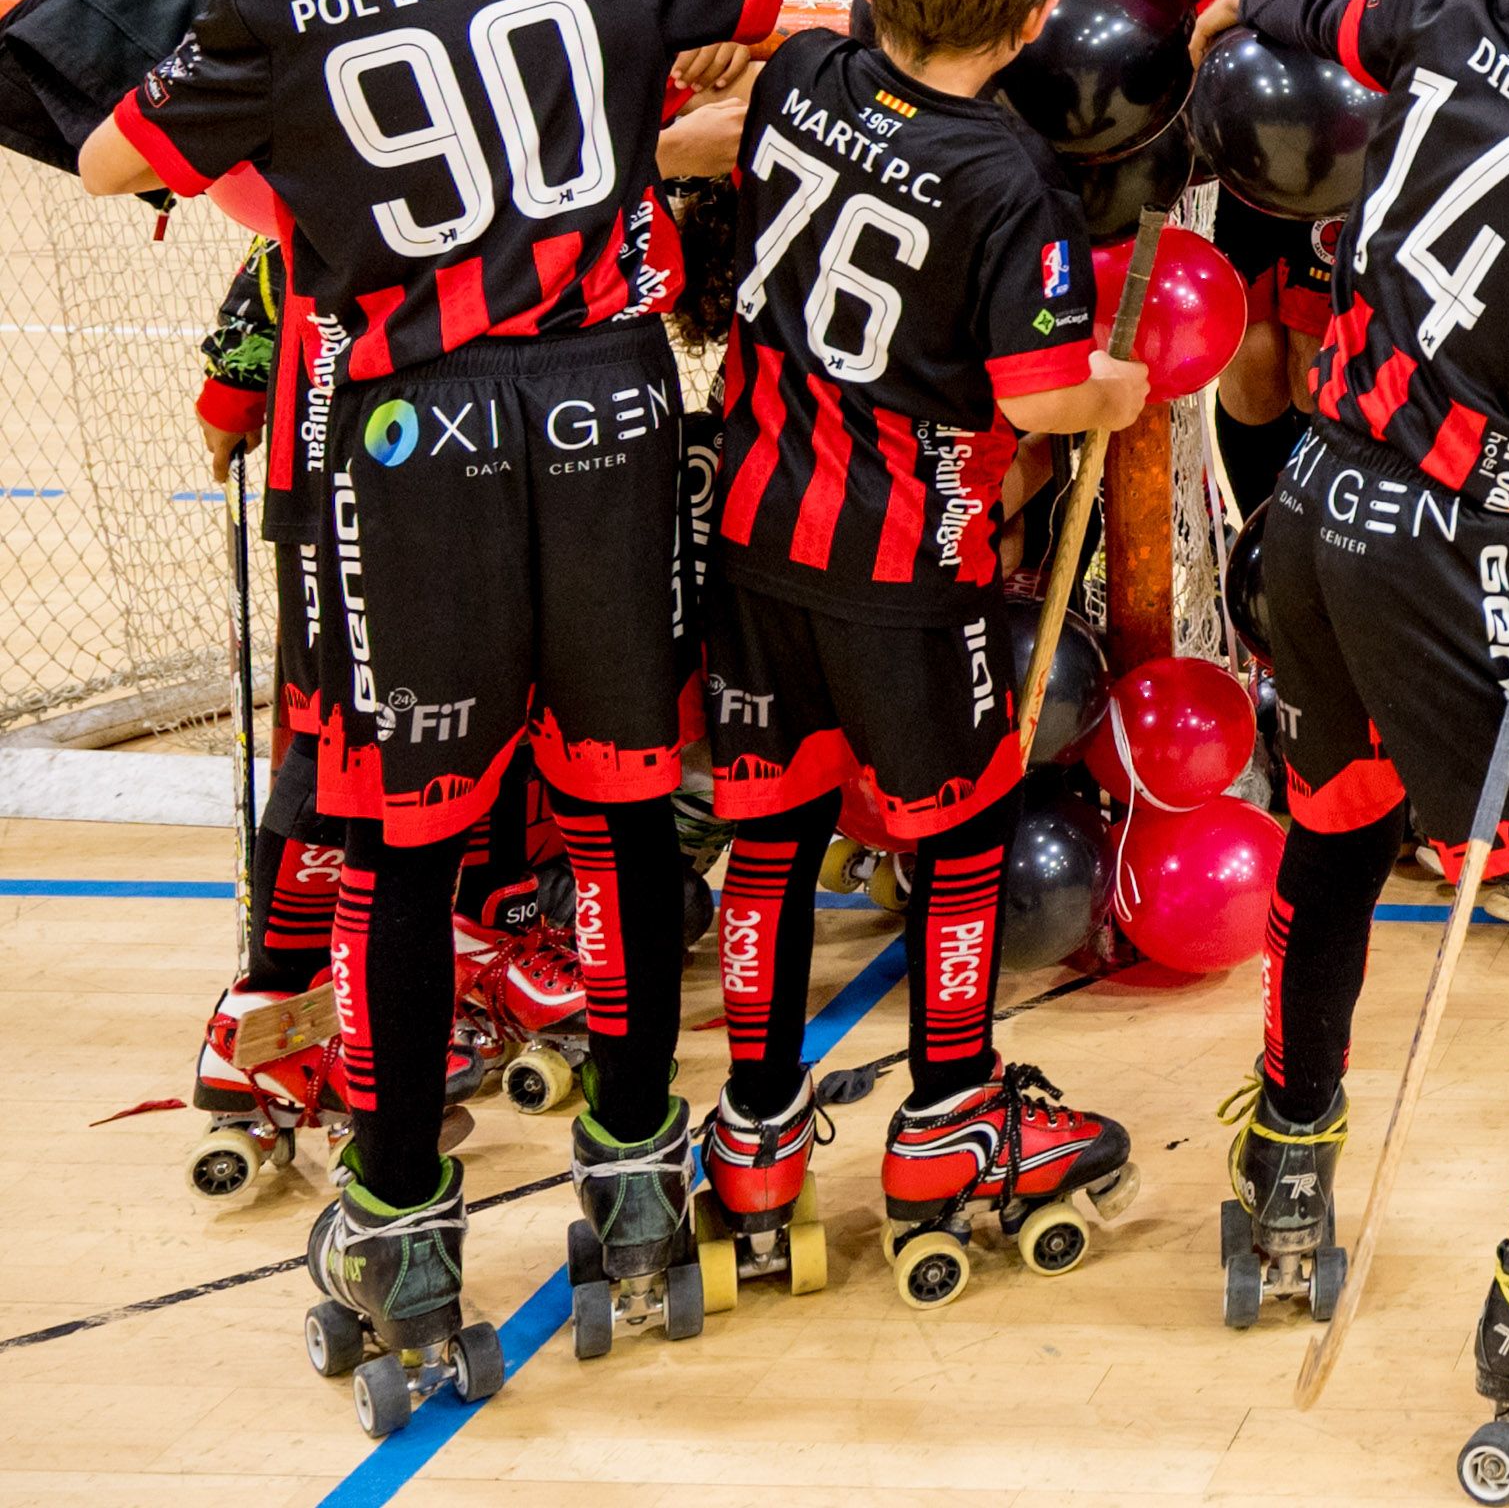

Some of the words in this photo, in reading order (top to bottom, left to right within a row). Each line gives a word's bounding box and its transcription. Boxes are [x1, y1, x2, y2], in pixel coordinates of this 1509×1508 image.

[781, 88, 889, 174] MARTÍ
[882, 155, 943, 209] P.C.
[858, 107, 902, 139] 1967
[737, 124, 931, 384] 76
[466, 459, 511, 478] DATA
[548, 452, 628, 476] CENTER
[936, 443, 972, 499] Sant
[936, 498, 983, 569] Cugat
[1279, 490, 1304, 516] DATA
[1318, 525, 1368, 555] CENTER
[410, 697, 477, 744] FiT
[720, 690, 775, 728] FiT
[574, 880, 607, 968] PHCSC
[723, 906, 762, 994] PHCSC
[937, 919, 986, 1004] PHCSC
